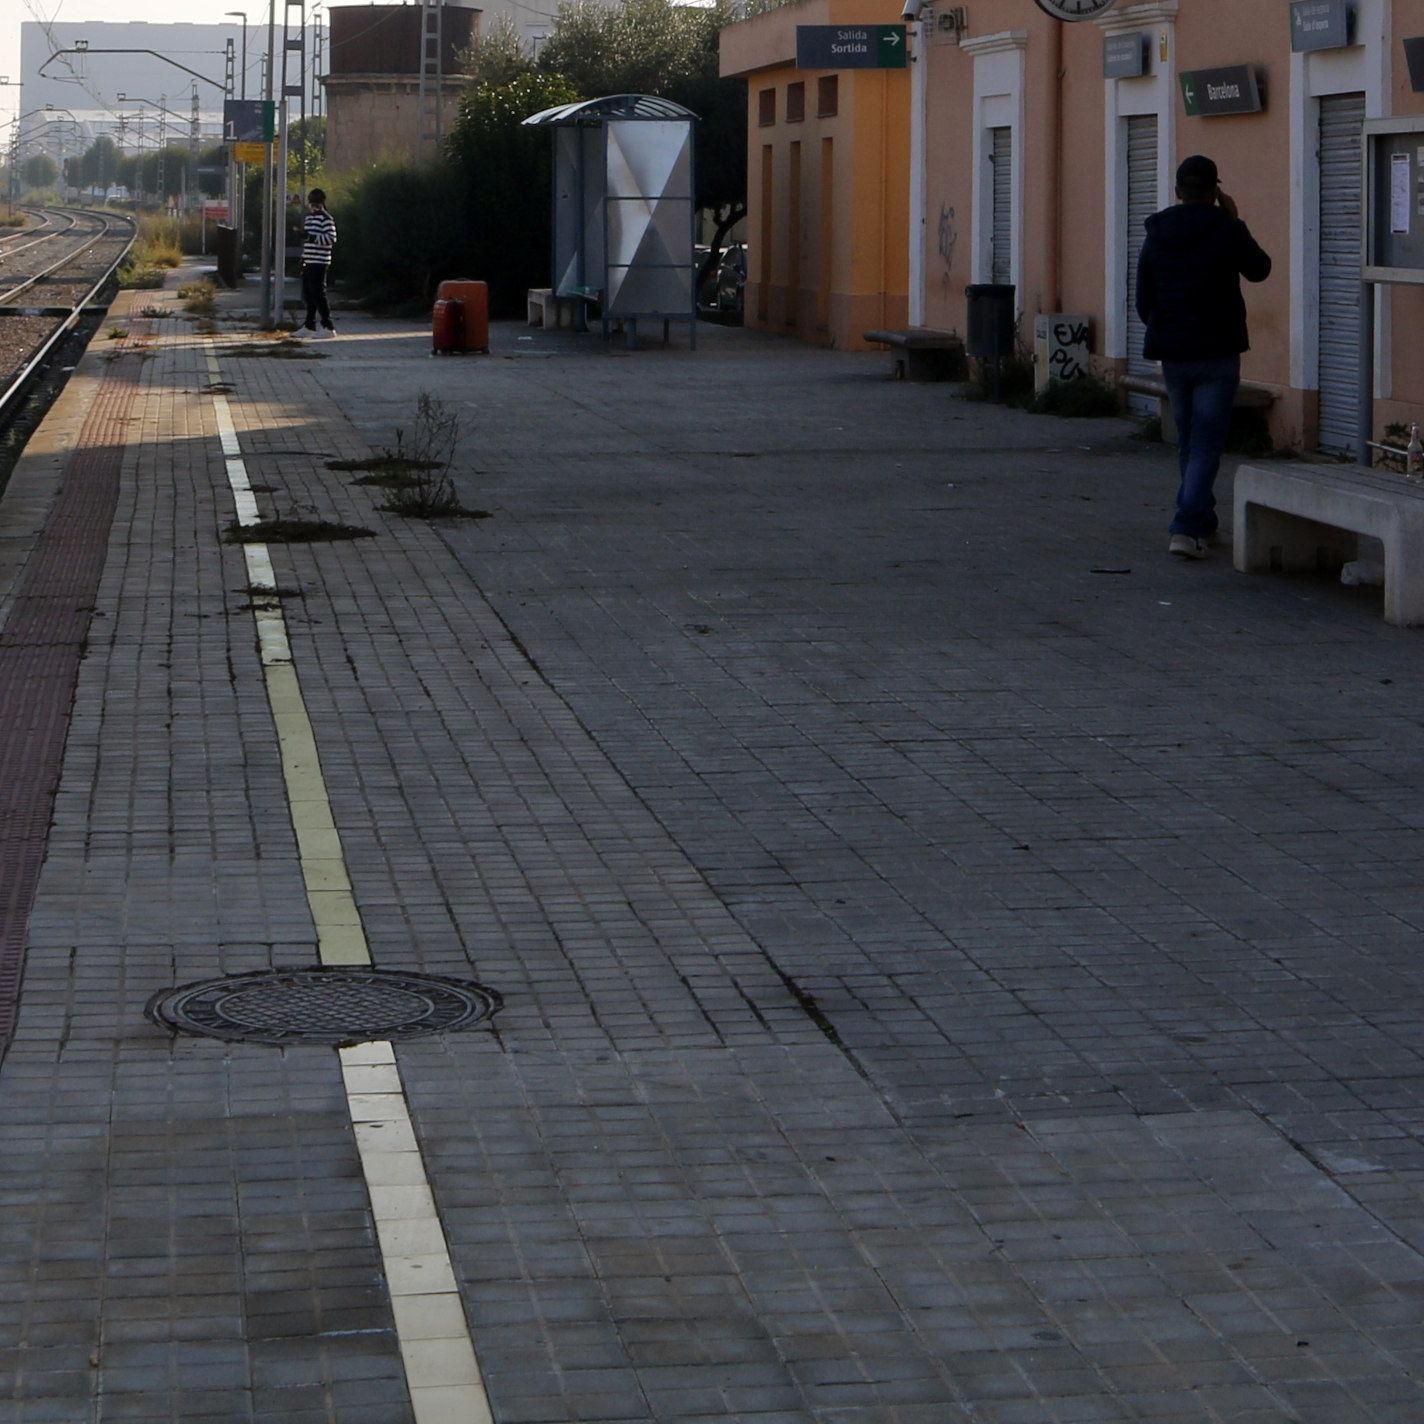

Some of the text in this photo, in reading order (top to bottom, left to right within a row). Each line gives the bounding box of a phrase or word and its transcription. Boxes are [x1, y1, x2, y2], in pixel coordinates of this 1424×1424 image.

[837, 30, 867, 40] Salida
[831, 43, 867, 53] Sortida
[1207, 84, 1240, 101] Barcelona
[226, 120, 237, 140] 1
